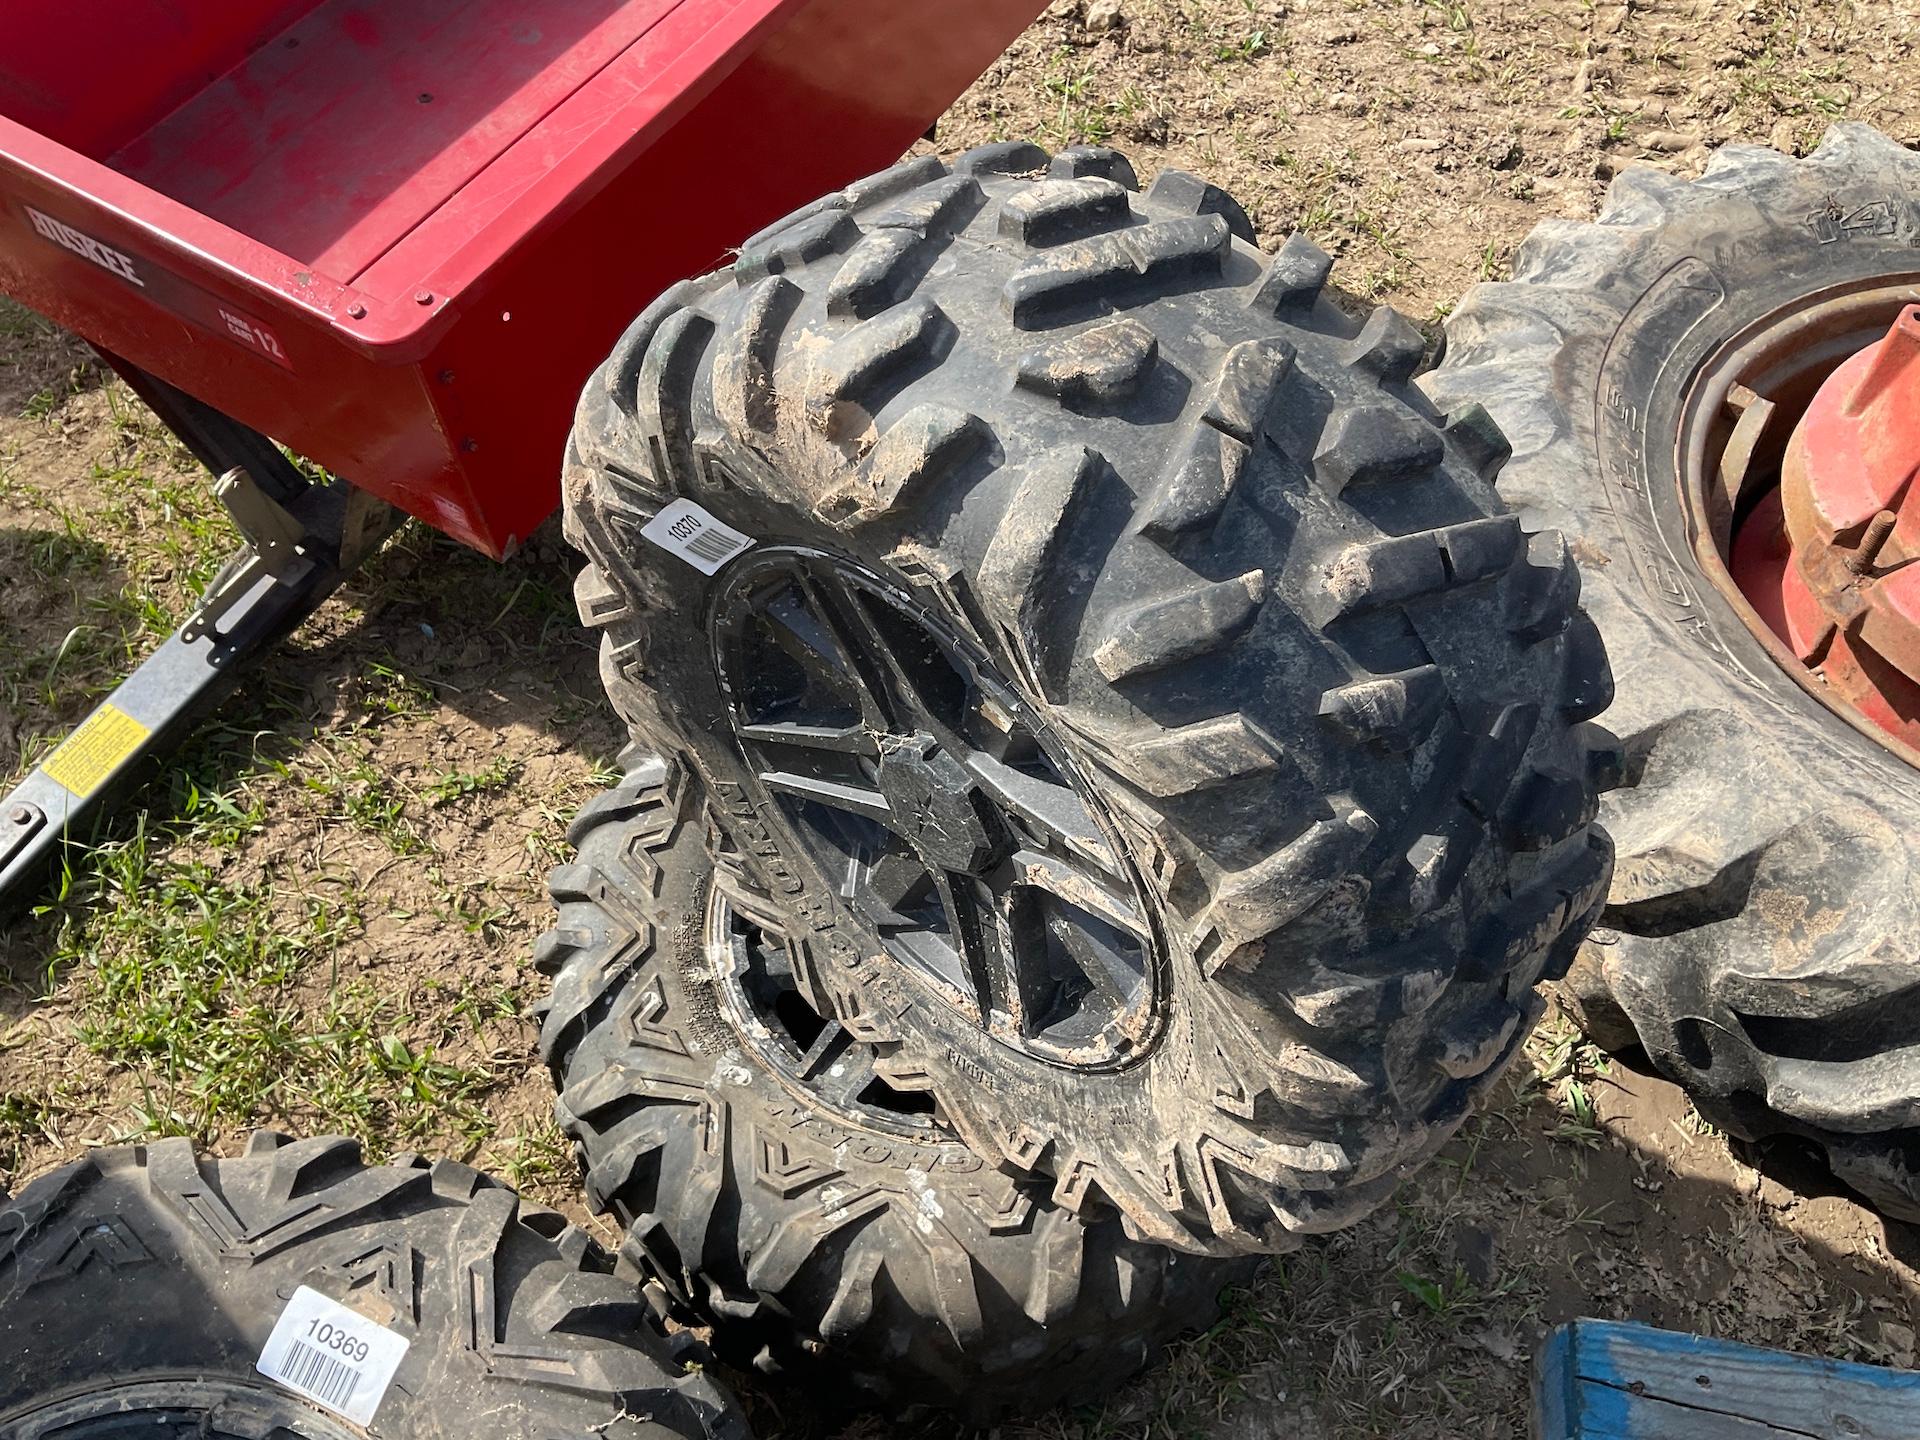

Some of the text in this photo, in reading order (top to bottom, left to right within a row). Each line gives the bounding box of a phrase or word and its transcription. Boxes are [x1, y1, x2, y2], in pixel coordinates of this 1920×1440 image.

[23, 204, 145, 289] HUSKEE
[253, 327, 285, 360] 12
[667, 514, 702, 542] 10370
[60, 721, 96, 755] CAUTION
[307, 1317, 370, 1362] 10369
